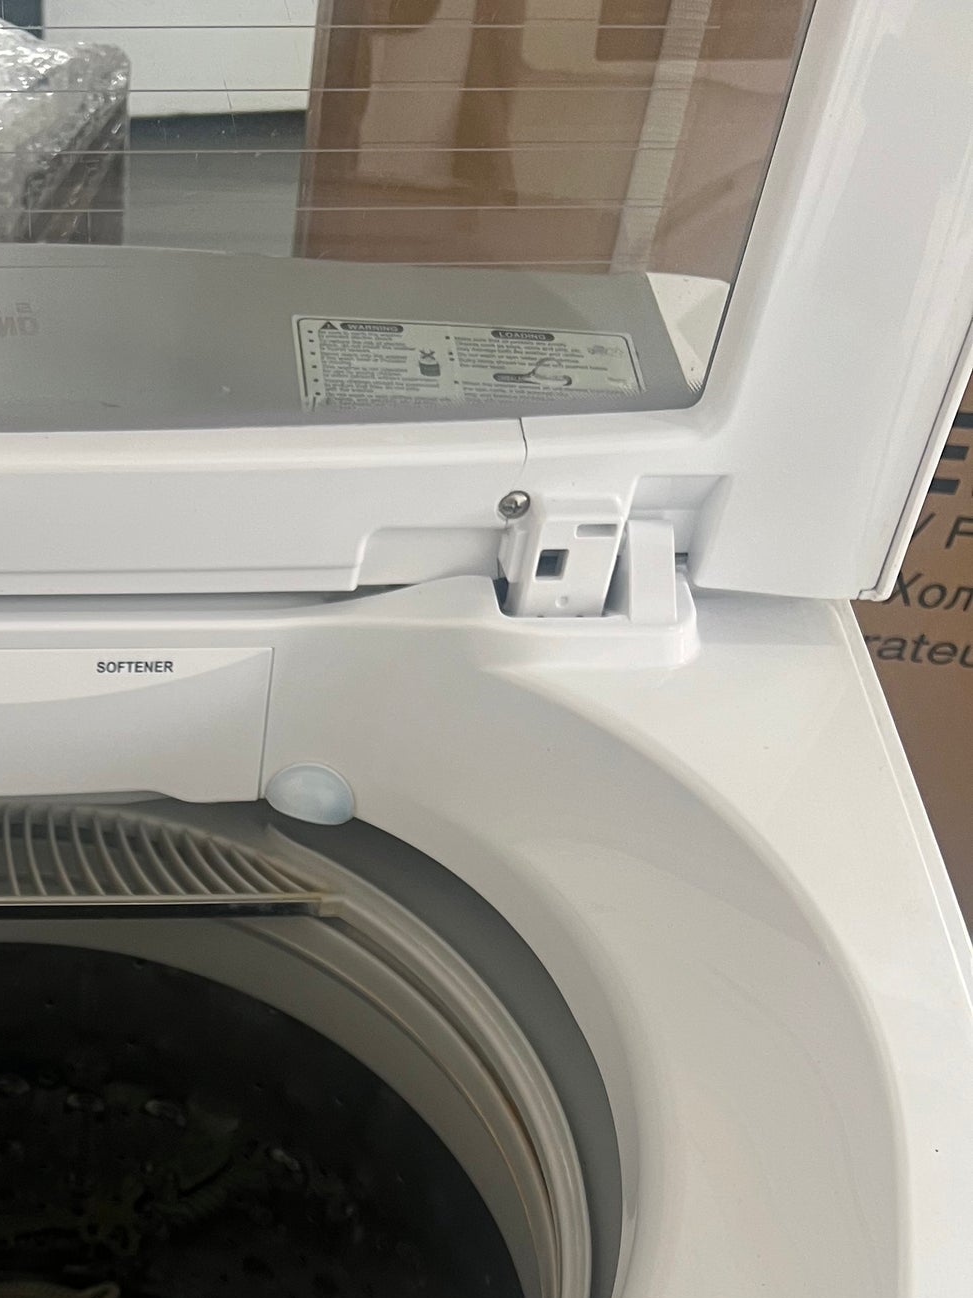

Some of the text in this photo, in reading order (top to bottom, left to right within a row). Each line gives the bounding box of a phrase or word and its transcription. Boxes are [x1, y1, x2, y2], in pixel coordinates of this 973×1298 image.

[347, 324, 399, 333] WARNING
[498, 331, 548, 341] LOADING
[96, 661, 174, 673] SOFTENER
